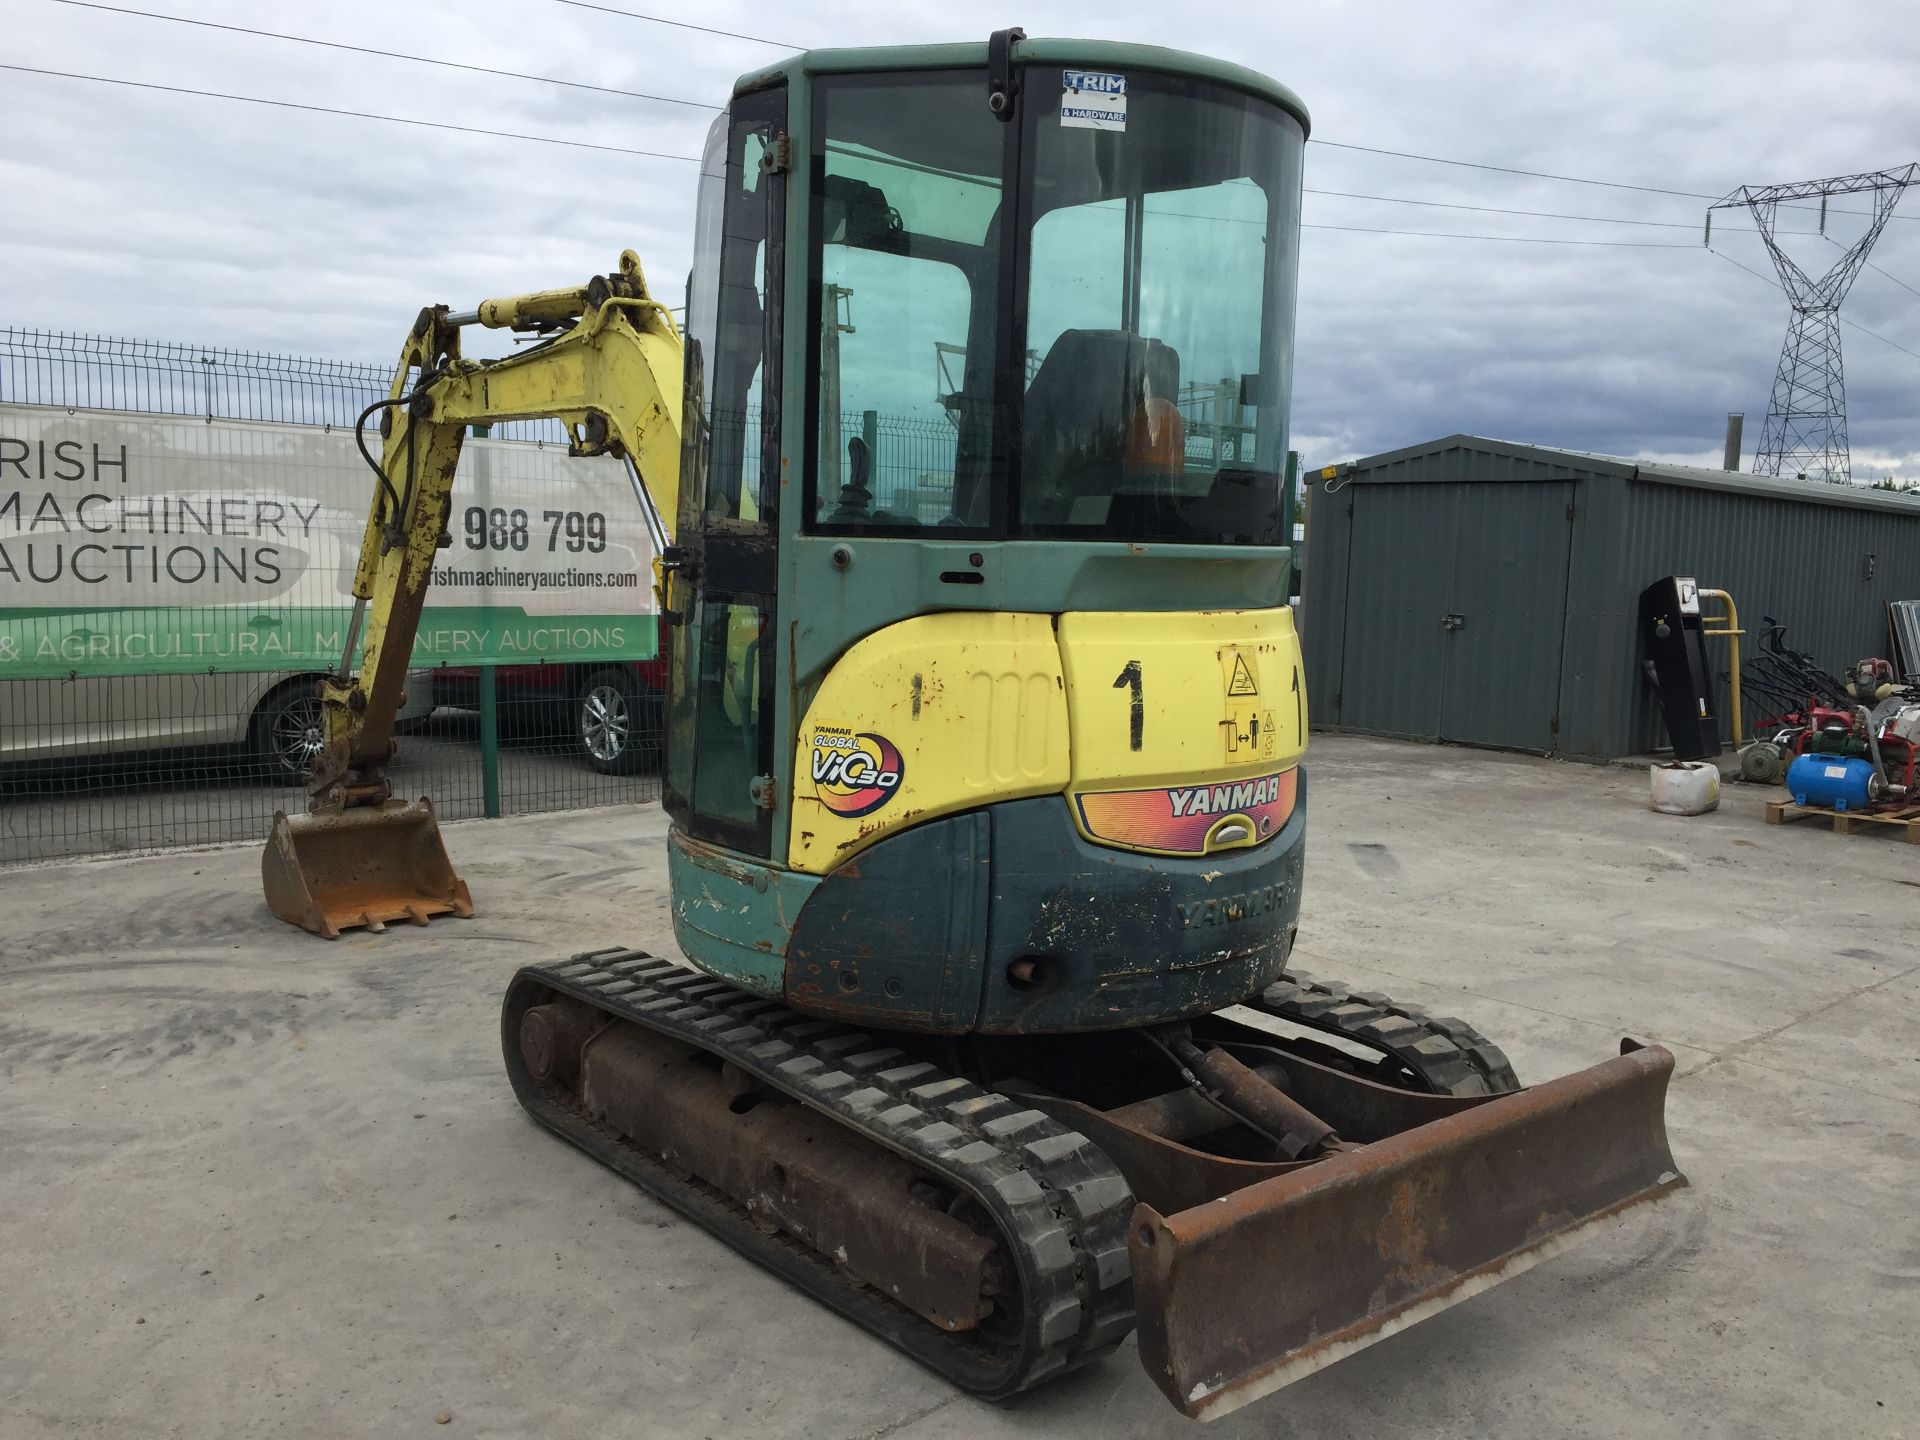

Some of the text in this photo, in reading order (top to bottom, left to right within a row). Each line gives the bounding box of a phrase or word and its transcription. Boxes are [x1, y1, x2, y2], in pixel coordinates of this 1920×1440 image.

[1066, 73, 1126, 93] TRIM
[1072, 110, 1124, 121] HARDWARE
[464, 506, 606, 553] 988 799
[0, 635, 20, 662] &
[34, 631, 304, 661] AGRICULTURAL
[499, 627, 625, 651] AUCTIONS
[1112, 660, 1144, 752] 1
[814, 735, 860, 750] GLOBAL
[815, 726, 851, 735] YANMAR
[1168, 776, 1279, 817] YANMAR
